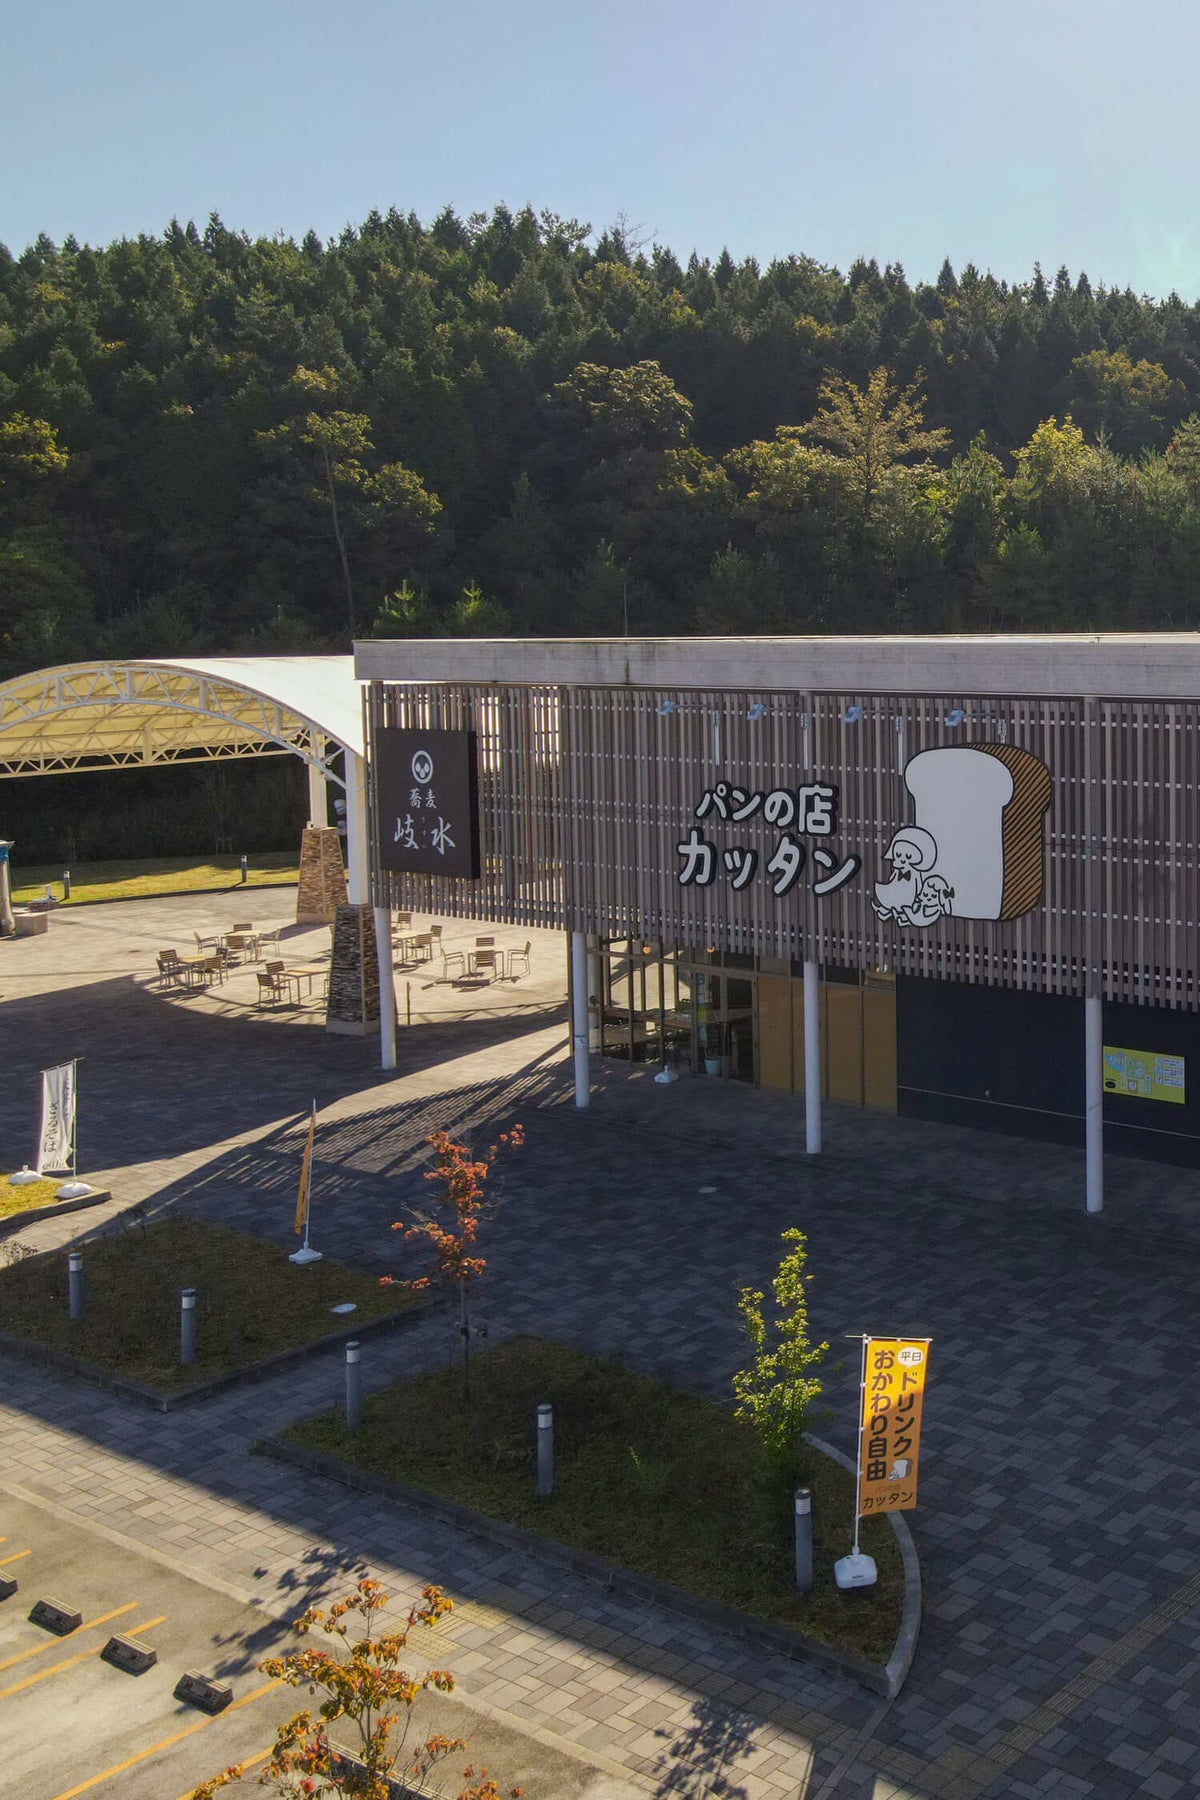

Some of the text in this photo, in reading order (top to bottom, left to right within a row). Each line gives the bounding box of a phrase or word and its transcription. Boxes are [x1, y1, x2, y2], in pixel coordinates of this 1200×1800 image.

[393, 813, 456, 856] 岐水
[696, 783, 835, 836] パンの店
[677, 828, 860, 896] カッタン
[899, 1351, 922, 1362] 平日
[866, 1350, 896, 1482] おかわり自由
[893, 1371, 918, 1457] ドリンク
[862, 1491, 915, 1509] カッタン
